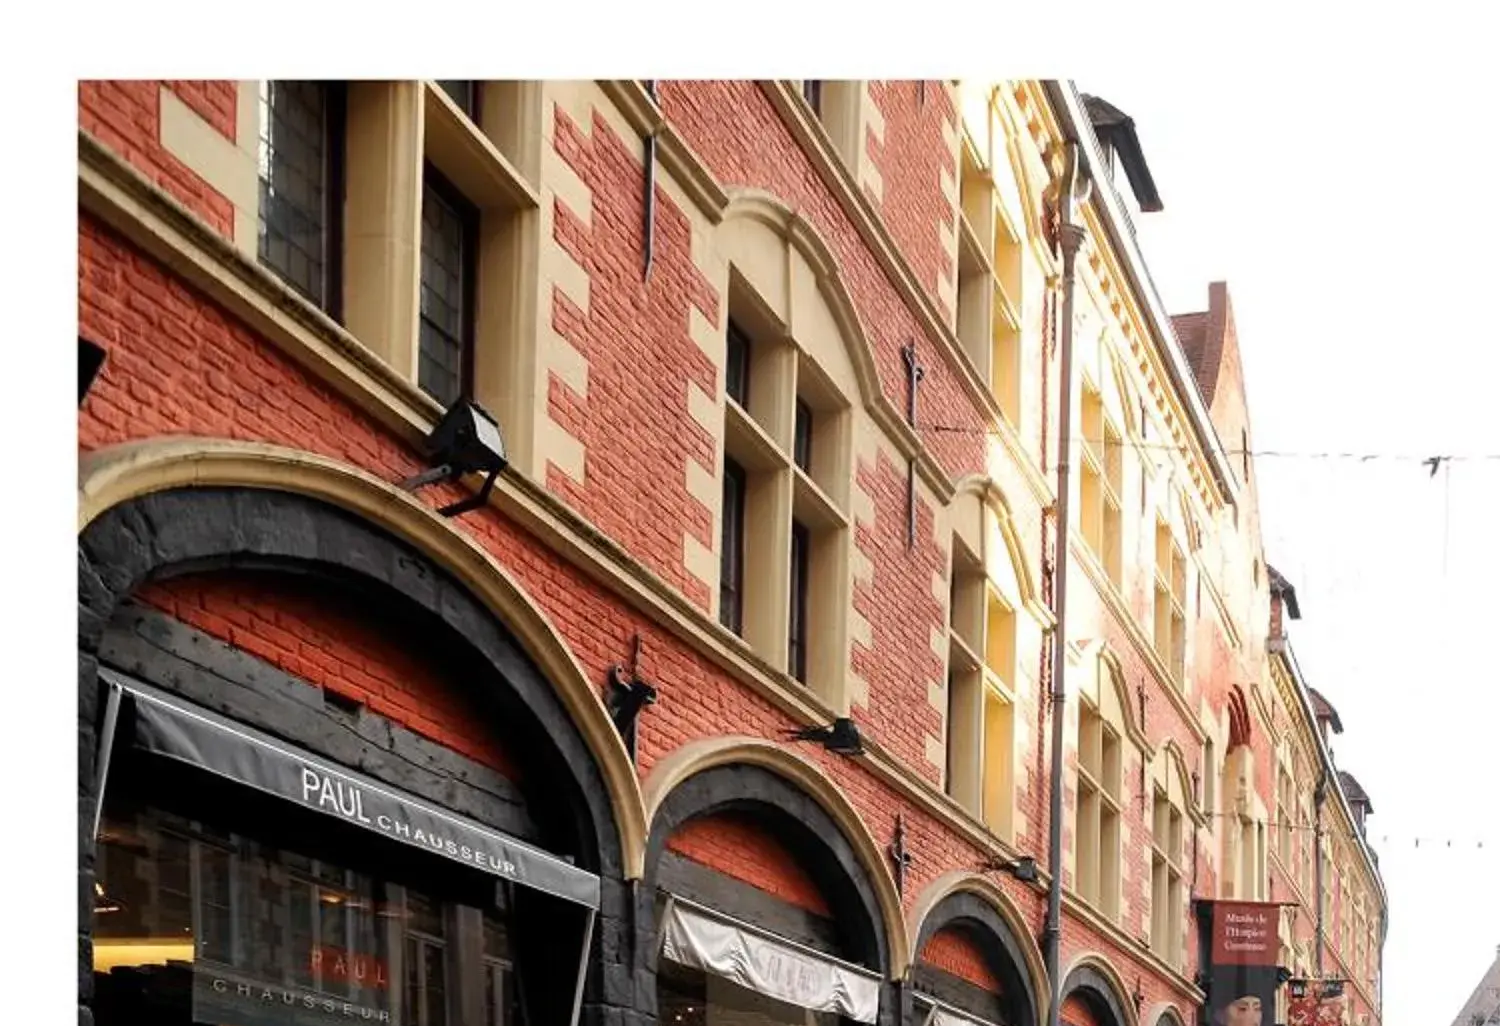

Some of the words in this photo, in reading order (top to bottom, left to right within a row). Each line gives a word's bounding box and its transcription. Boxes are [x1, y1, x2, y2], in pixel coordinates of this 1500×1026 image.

[303, 767, 371, 824] PAUL
[376, 815, 518, 877] CHAUSSEUR
[311, 944, 386, 983] PAUL
[213, 979, 390, 1023] CHAUSSEUR
